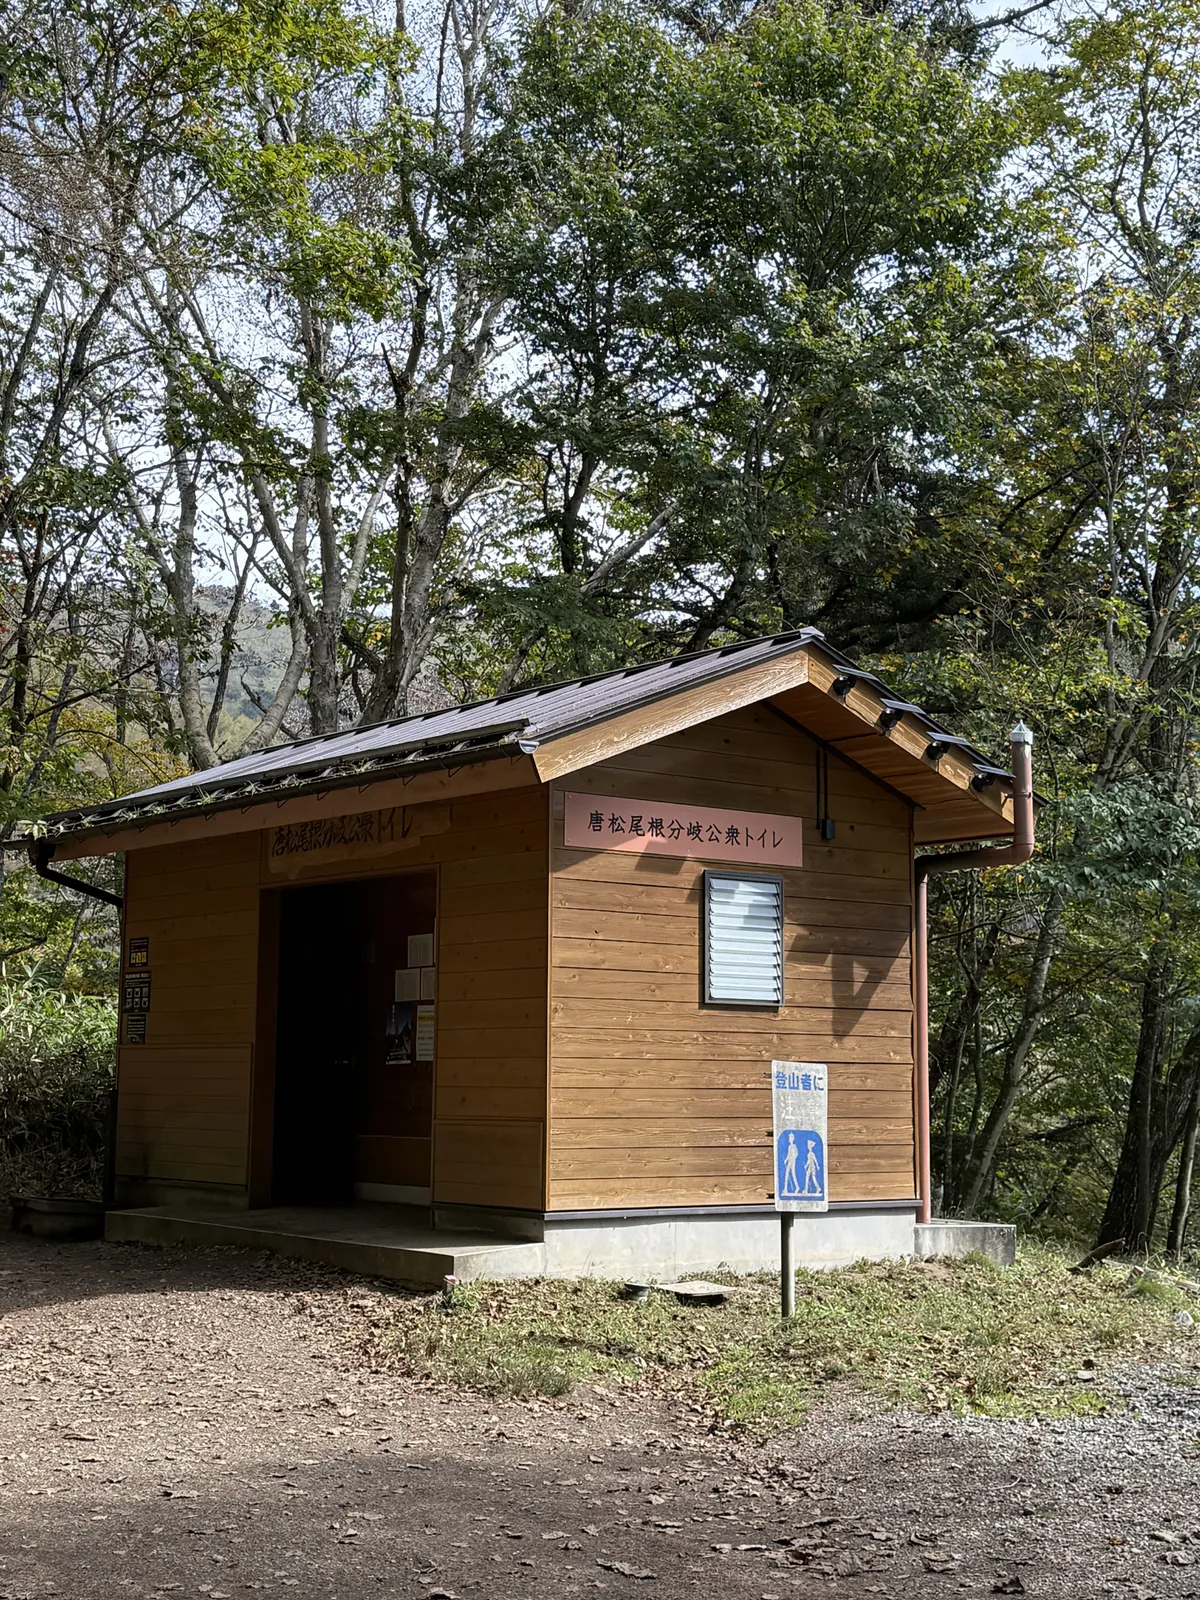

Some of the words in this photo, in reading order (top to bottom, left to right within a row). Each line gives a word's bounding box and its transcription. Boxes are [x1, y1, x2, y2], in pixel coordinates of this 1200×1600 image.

[587, 810, 784, 849] 唐松尾根分岐公衆トイレ
[775, 1070, 825, 1091] 登山者に
